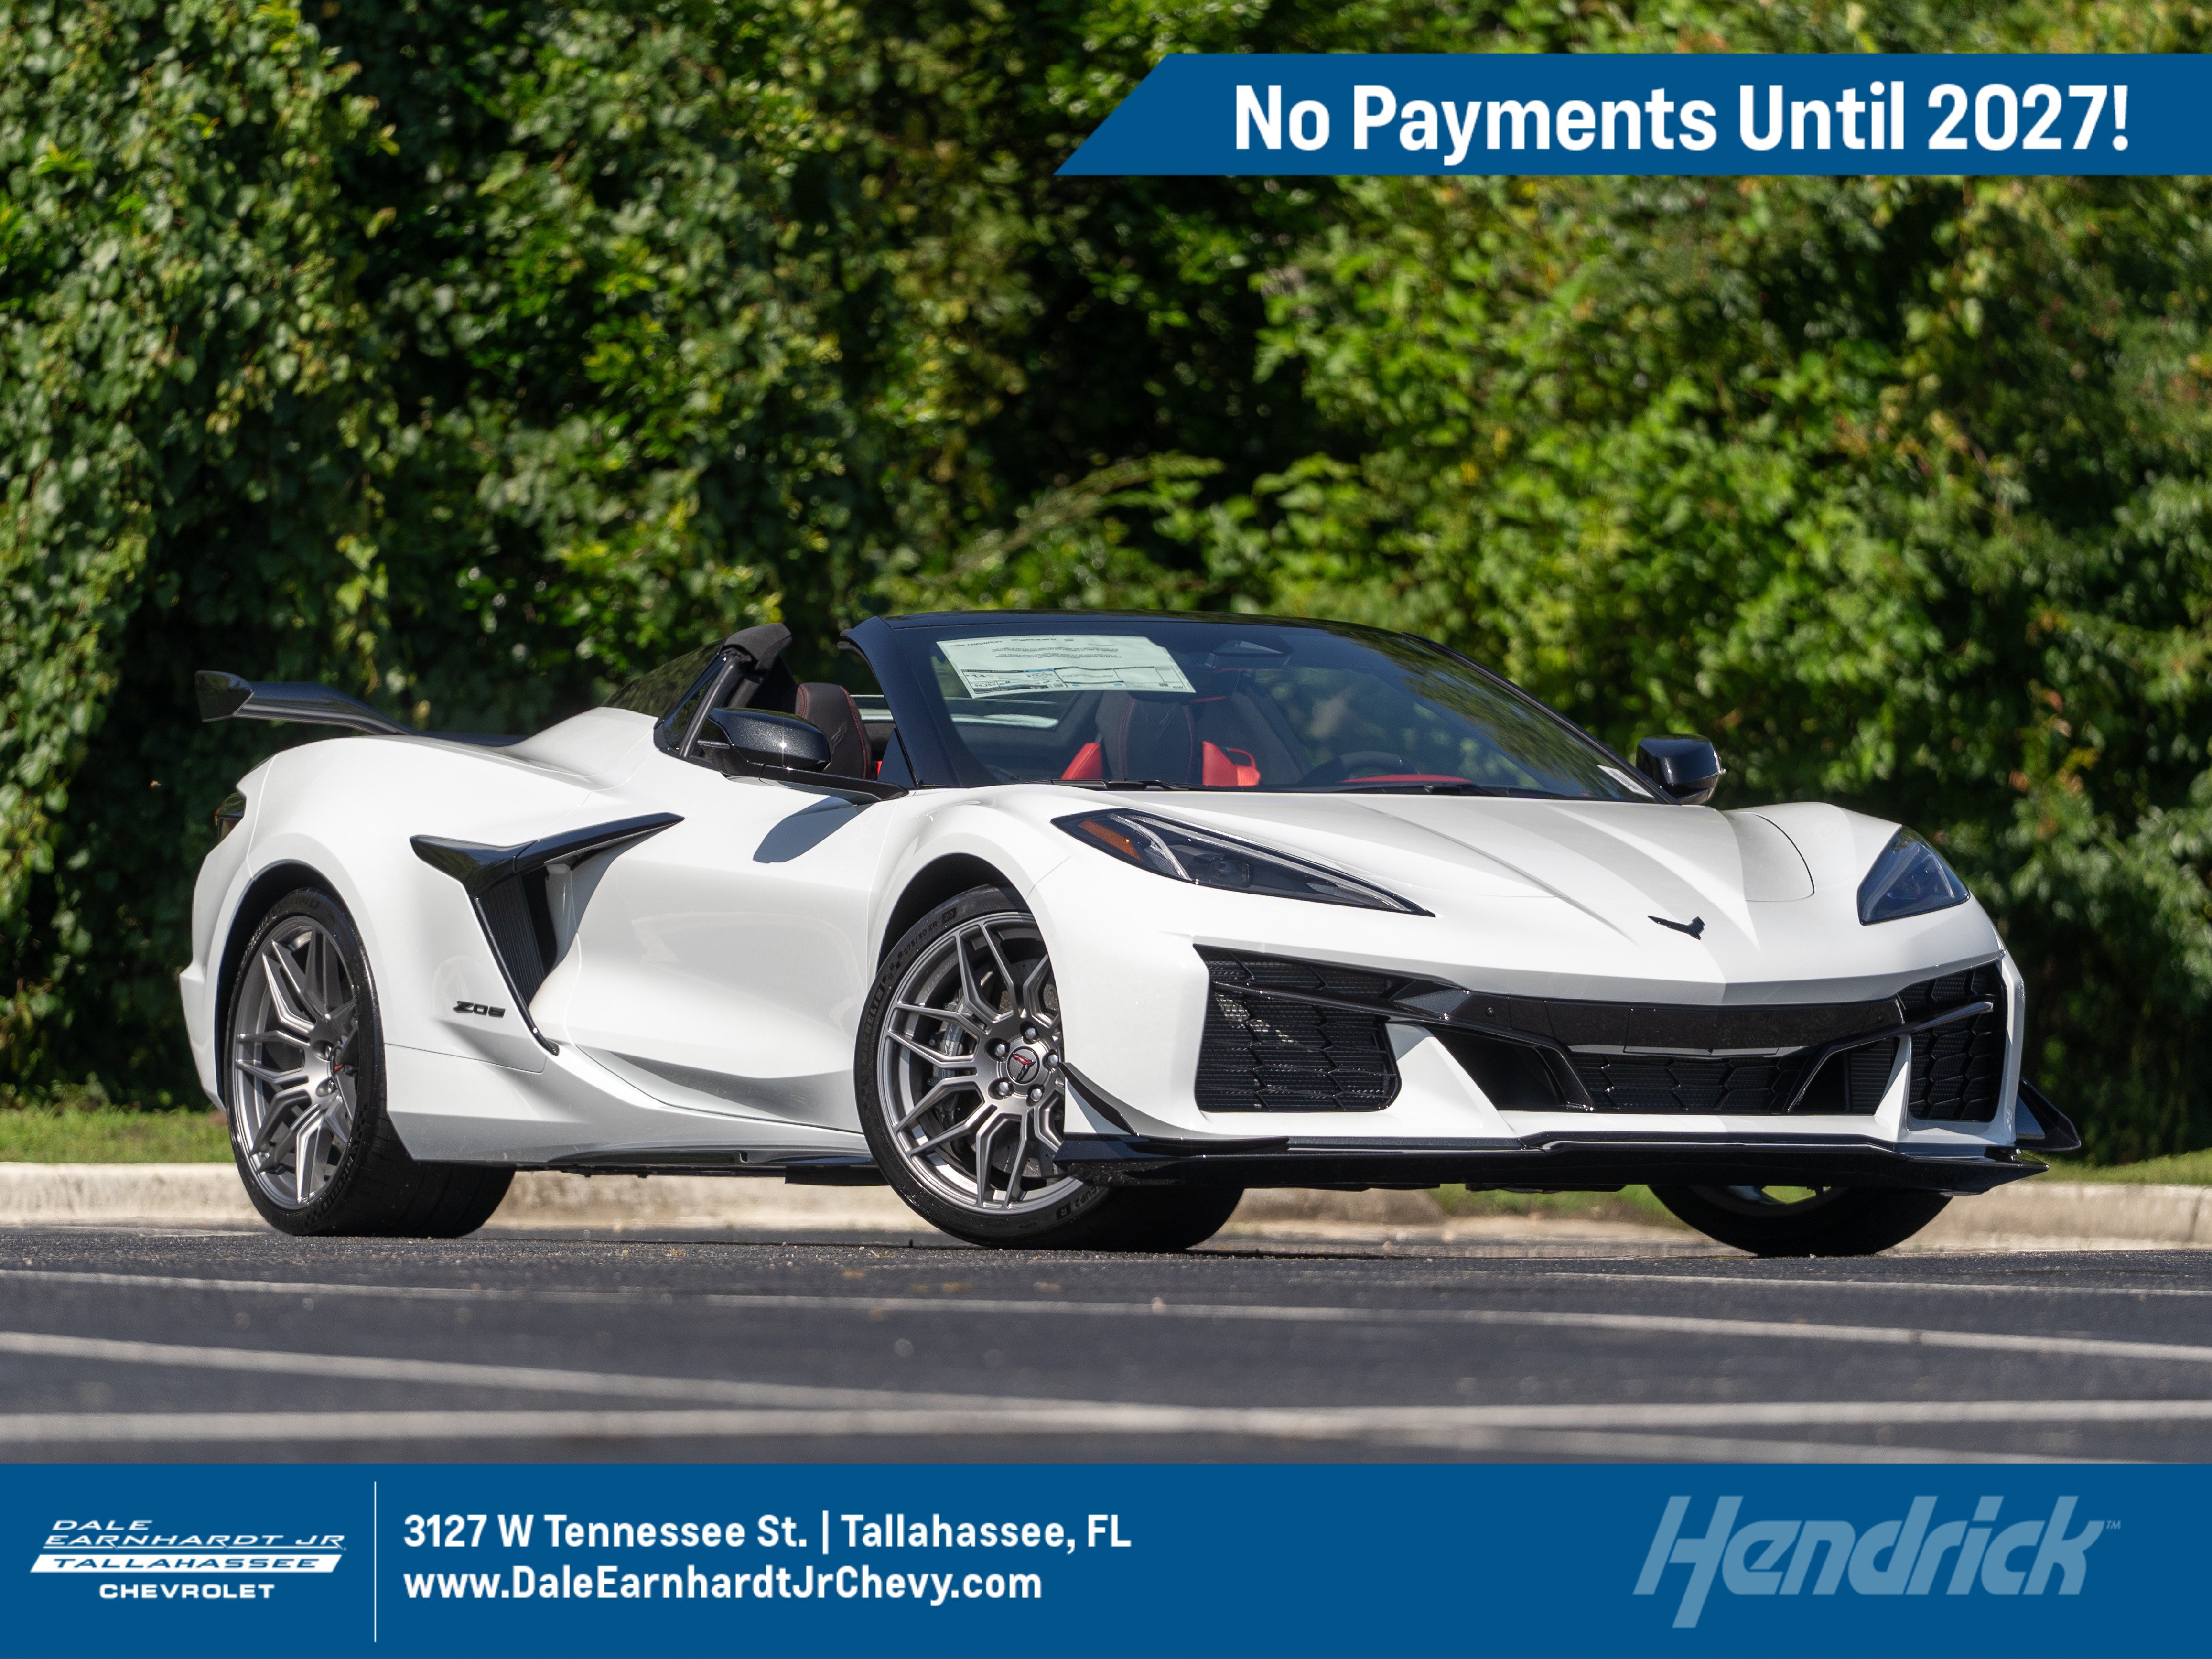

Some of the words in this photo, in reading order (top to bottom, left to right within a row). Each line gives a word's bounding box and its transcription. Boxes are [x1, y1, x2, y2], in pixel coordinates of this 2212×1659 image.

[928, 921, 938, 933] ZR
[944, 911, 954, 921] 20
[921, 957, 958, 996] ORVETTE
[453, 1000, 506, 1018] Z06
[861, 986, 885, 1064] MICHELIN
